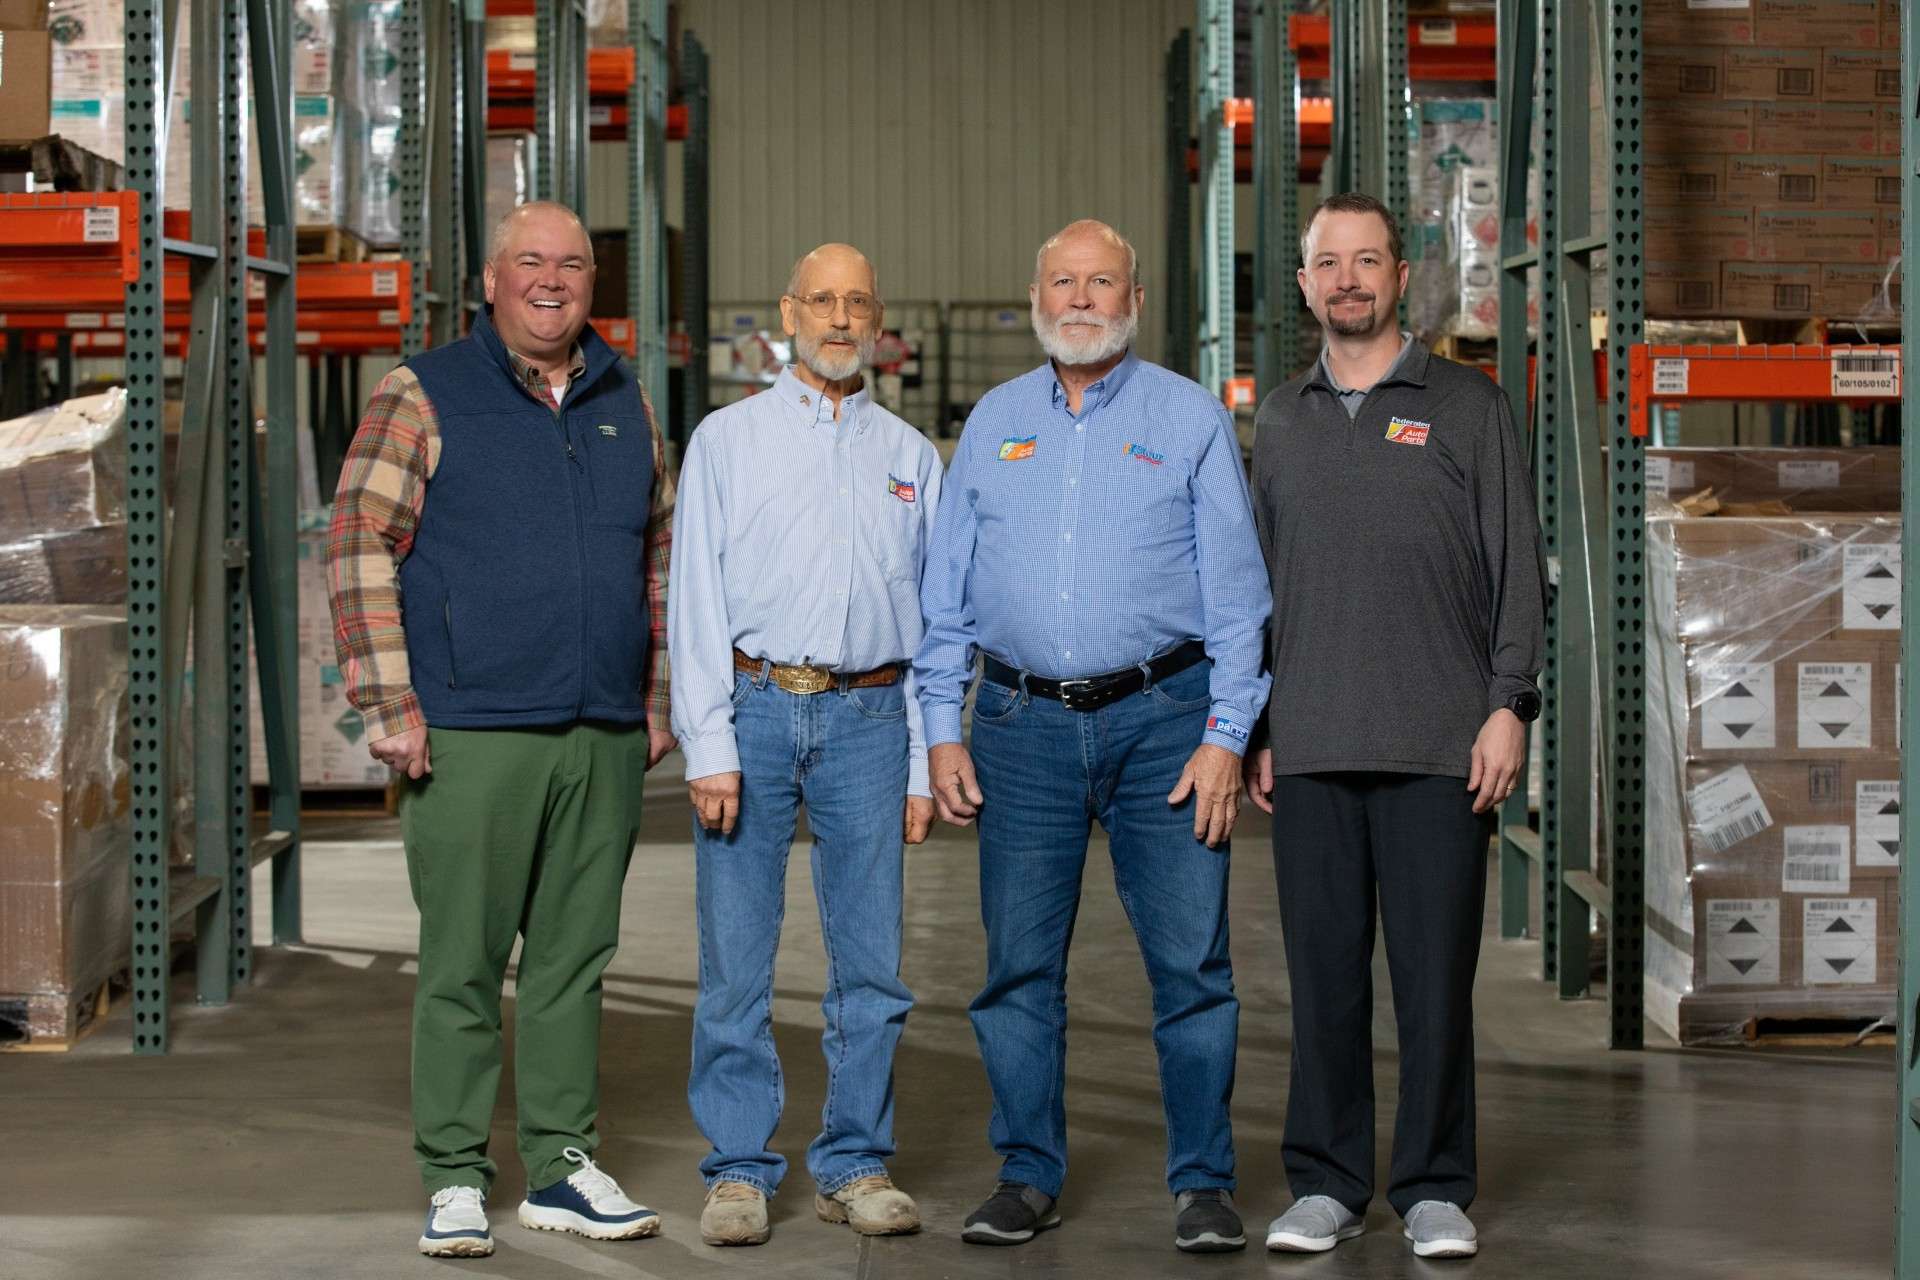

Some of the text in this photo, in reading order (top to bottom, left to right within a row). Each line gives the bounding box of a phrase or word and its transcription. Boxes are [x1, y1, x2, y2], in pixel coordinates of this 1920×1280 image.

[1839, 380, 1891, 388] 60/105/0102
[1406, 430, 1426, 438] Auto
[1401, 435, 1425, 444] Parts
